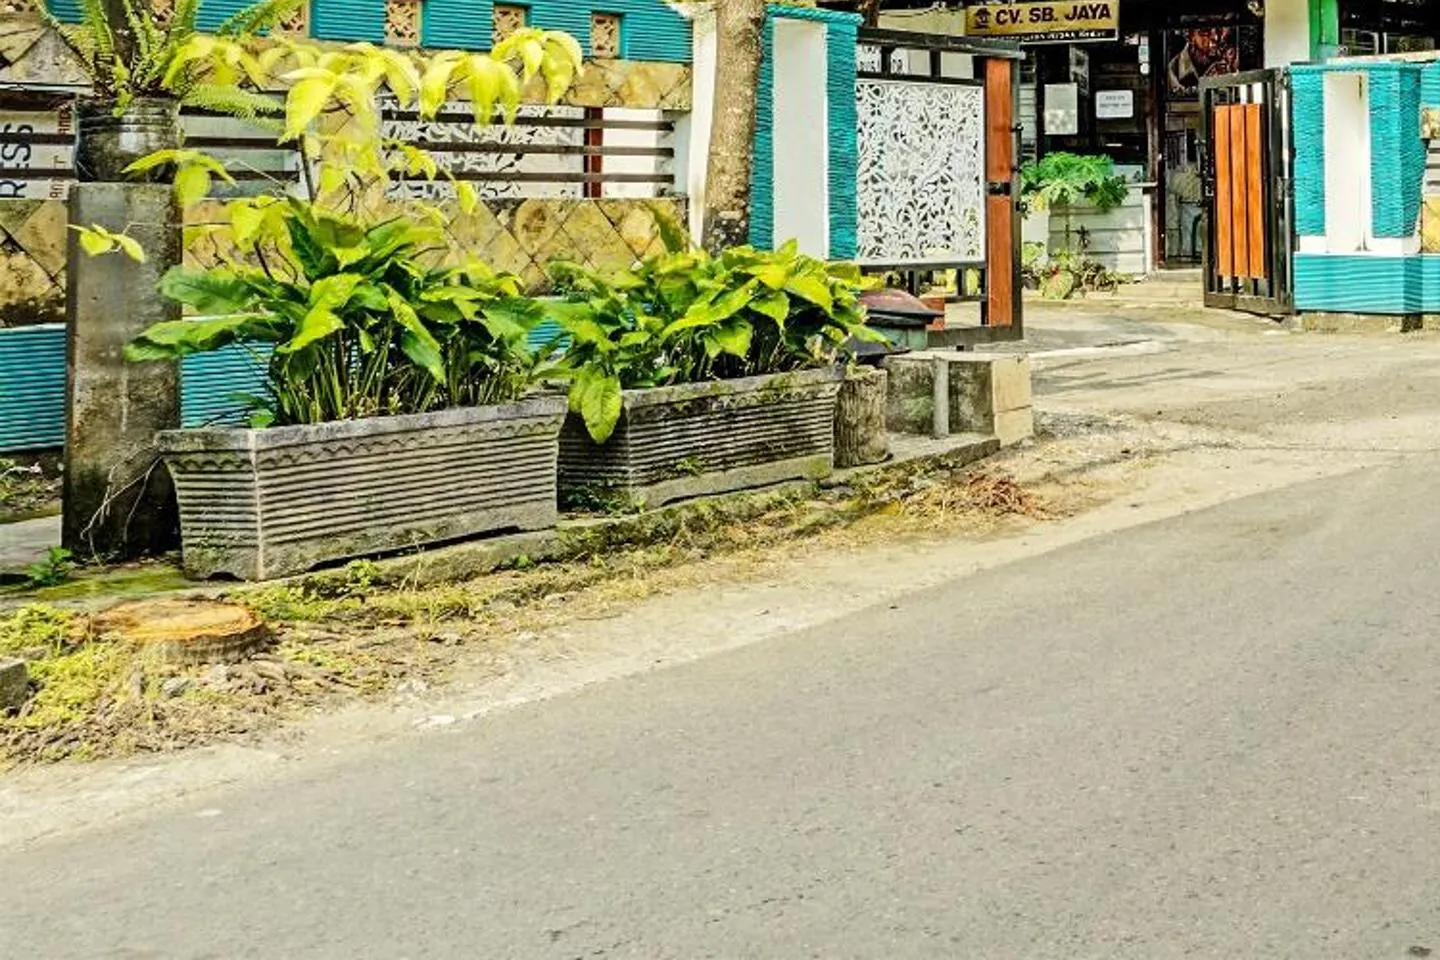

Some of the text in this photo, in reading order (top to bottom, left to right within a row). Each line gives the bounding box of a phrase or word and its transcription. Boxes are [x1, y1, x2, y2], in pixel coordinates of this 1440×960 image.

[995, 3, 1111, 25] CV. SB. JAYA
